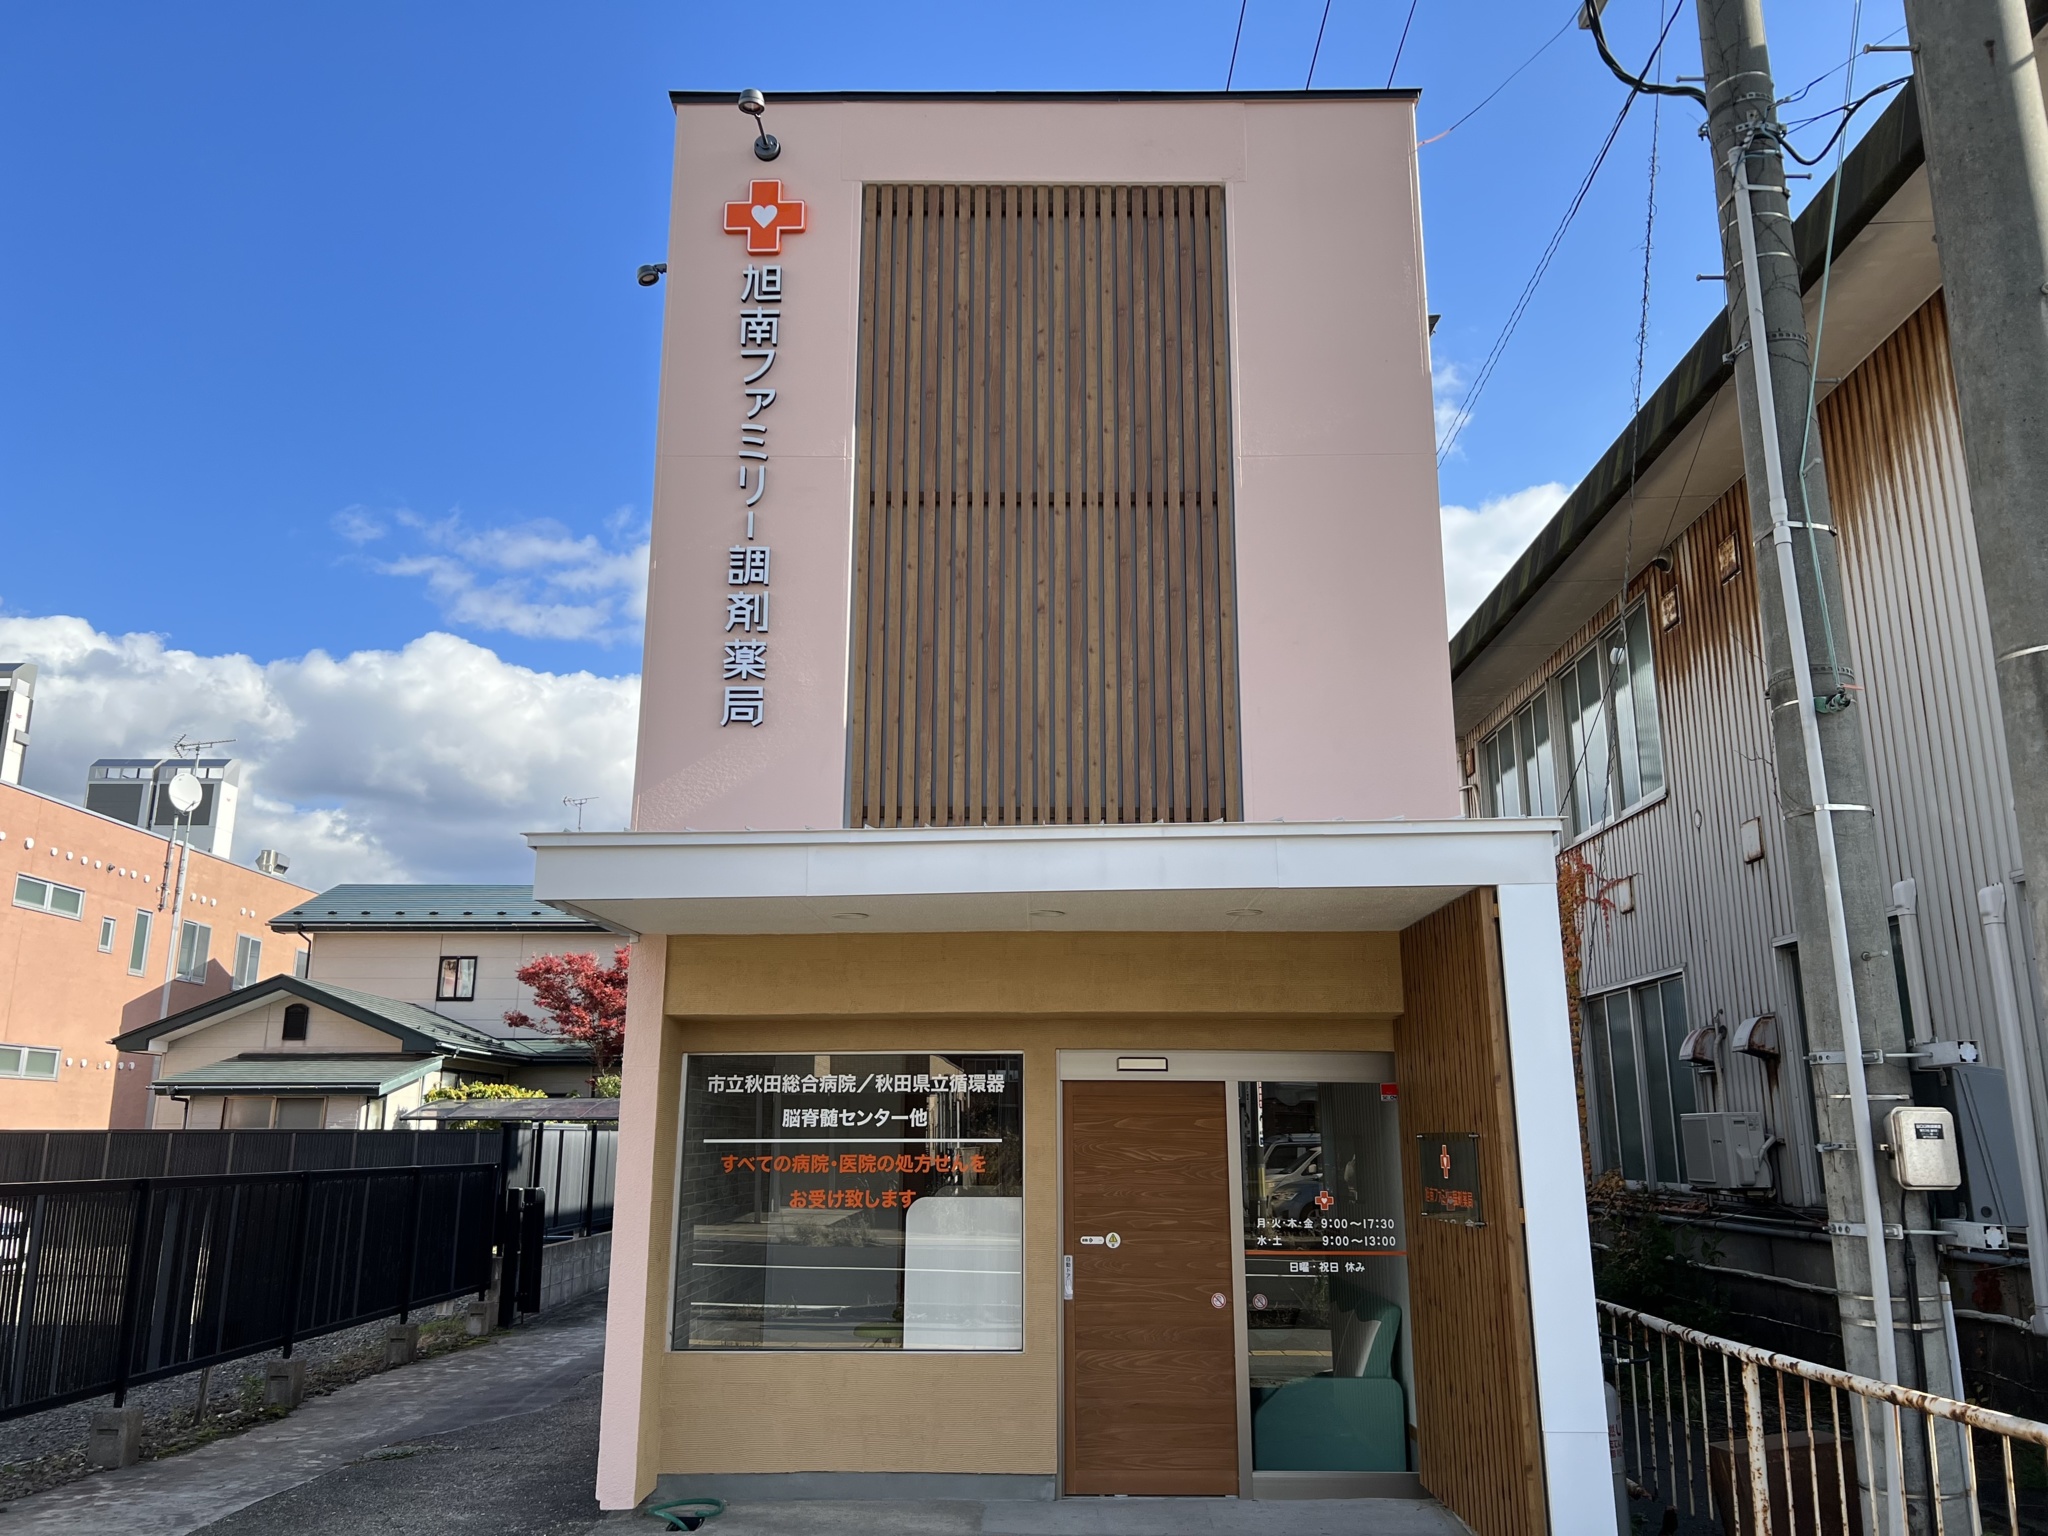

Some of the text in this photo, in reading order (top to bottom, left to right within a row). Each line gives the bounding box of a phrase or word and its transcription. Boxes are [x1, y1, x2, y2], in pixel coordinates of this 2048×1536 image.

[719, 264, 783, 727] 旭南ファミリー調剤薬局
[707, 1073, 1005, 1094] 市立秋田総合病院／秋田県立循環器
[781, 1107, 928, 1128] 脳脊髄センター他
[721, 1154, 986, 1175] すべての病院・医院の処方せんを
[789, 1189, 917, 1210] お受け致します
[1257, 1235, 1283, 1246] 水・土
[1344, 1262, 1366, 1273] 休み
